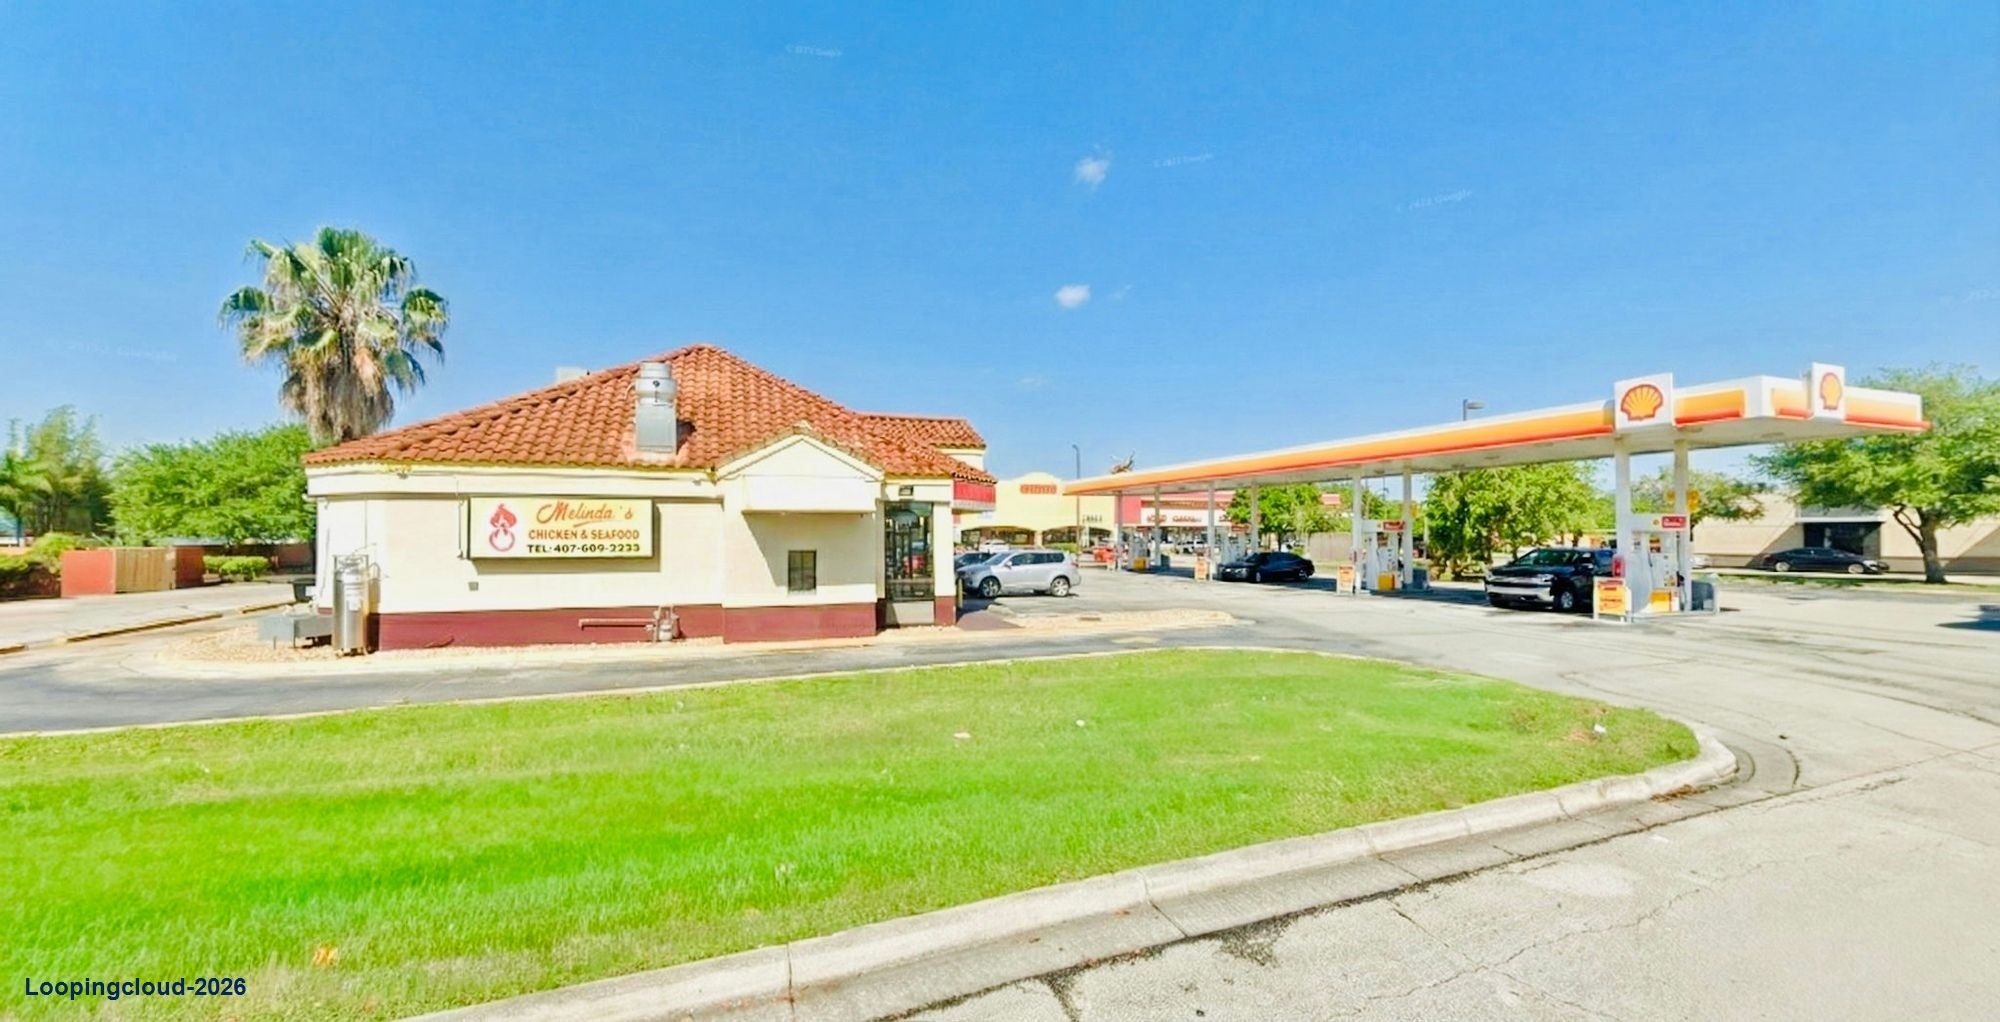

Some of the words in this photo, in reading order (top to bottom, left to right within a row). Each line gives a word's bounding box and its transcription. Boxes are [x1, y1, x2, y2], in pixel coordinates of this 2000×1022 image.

[528, 529, 578, 540] CHICKEN
[580, 529, 588, 540] &
[590, 529, 640, 540] SEAFOOD
